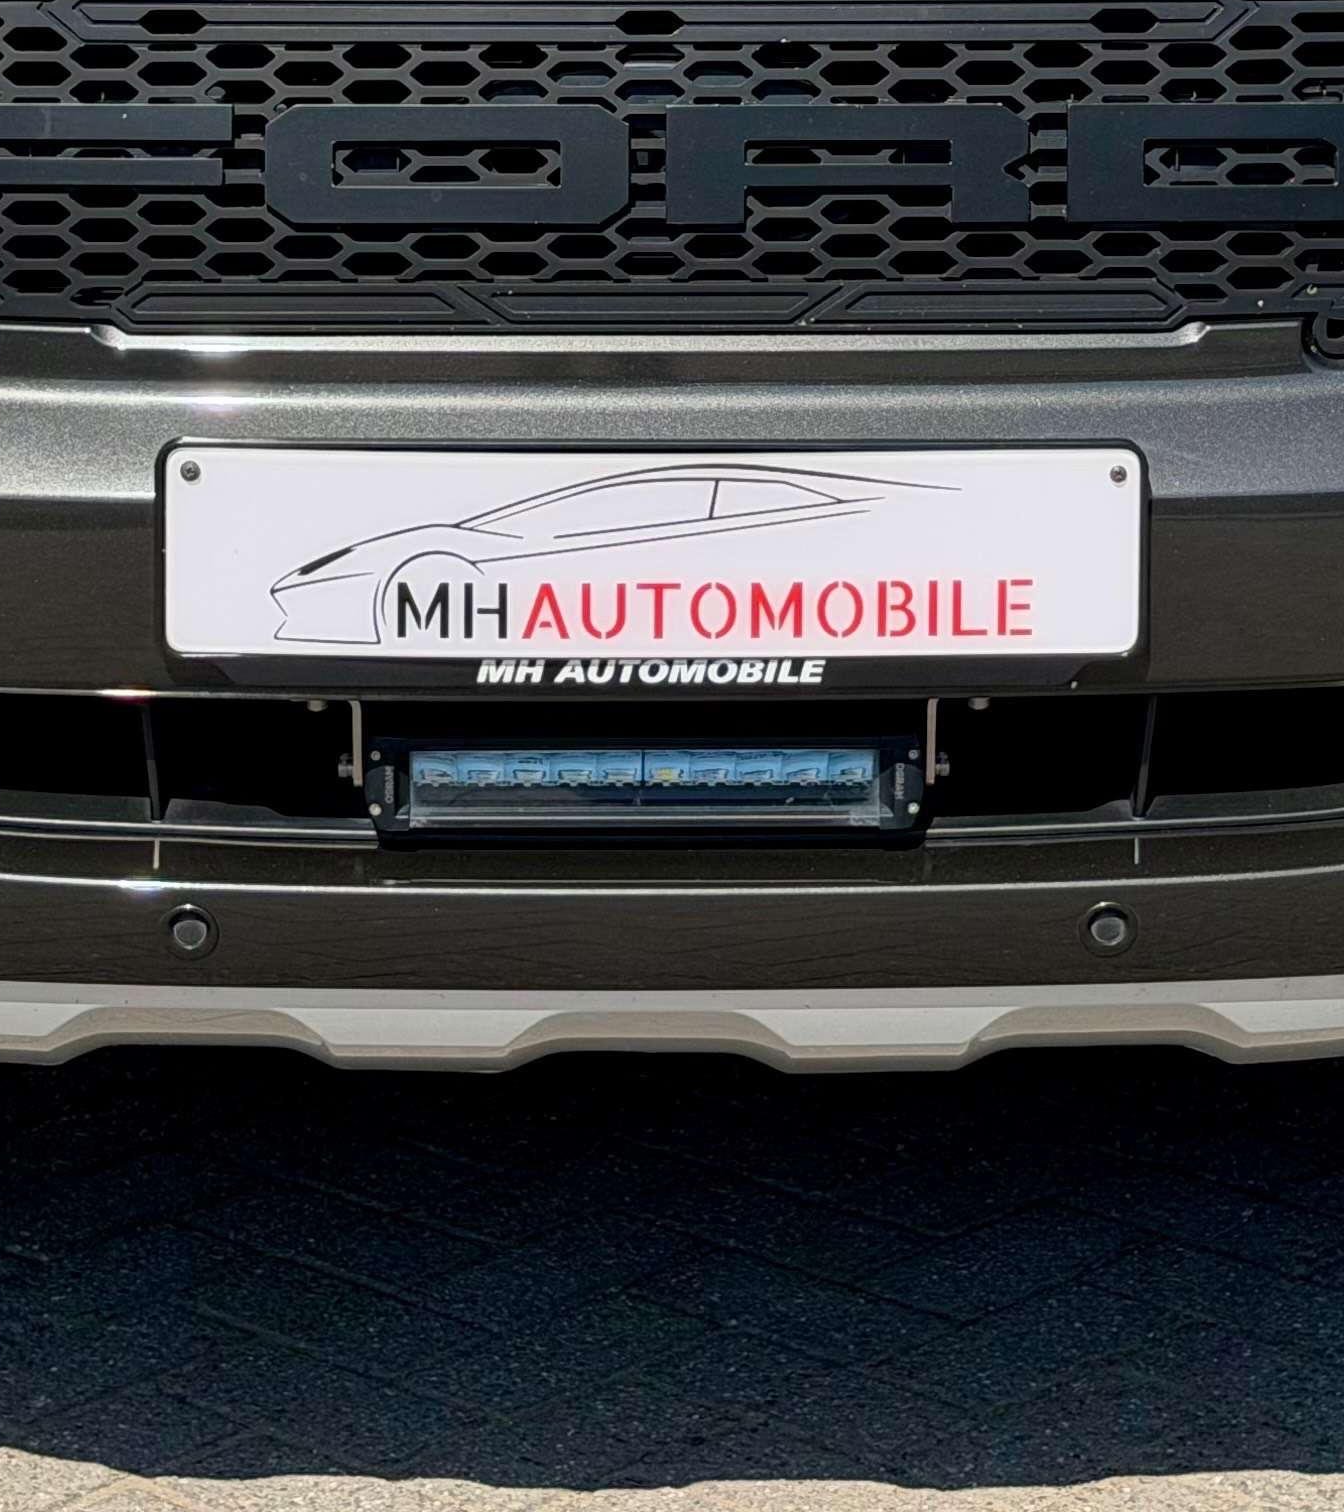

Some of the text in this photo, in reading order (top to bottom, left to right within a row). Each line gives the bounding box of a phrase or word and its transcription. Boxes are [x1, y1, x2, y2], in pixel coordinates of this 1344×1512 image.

[476, 658, 826, 684] MH AUTOMOBILE
[383, 764, 395, 804] OSRAM
